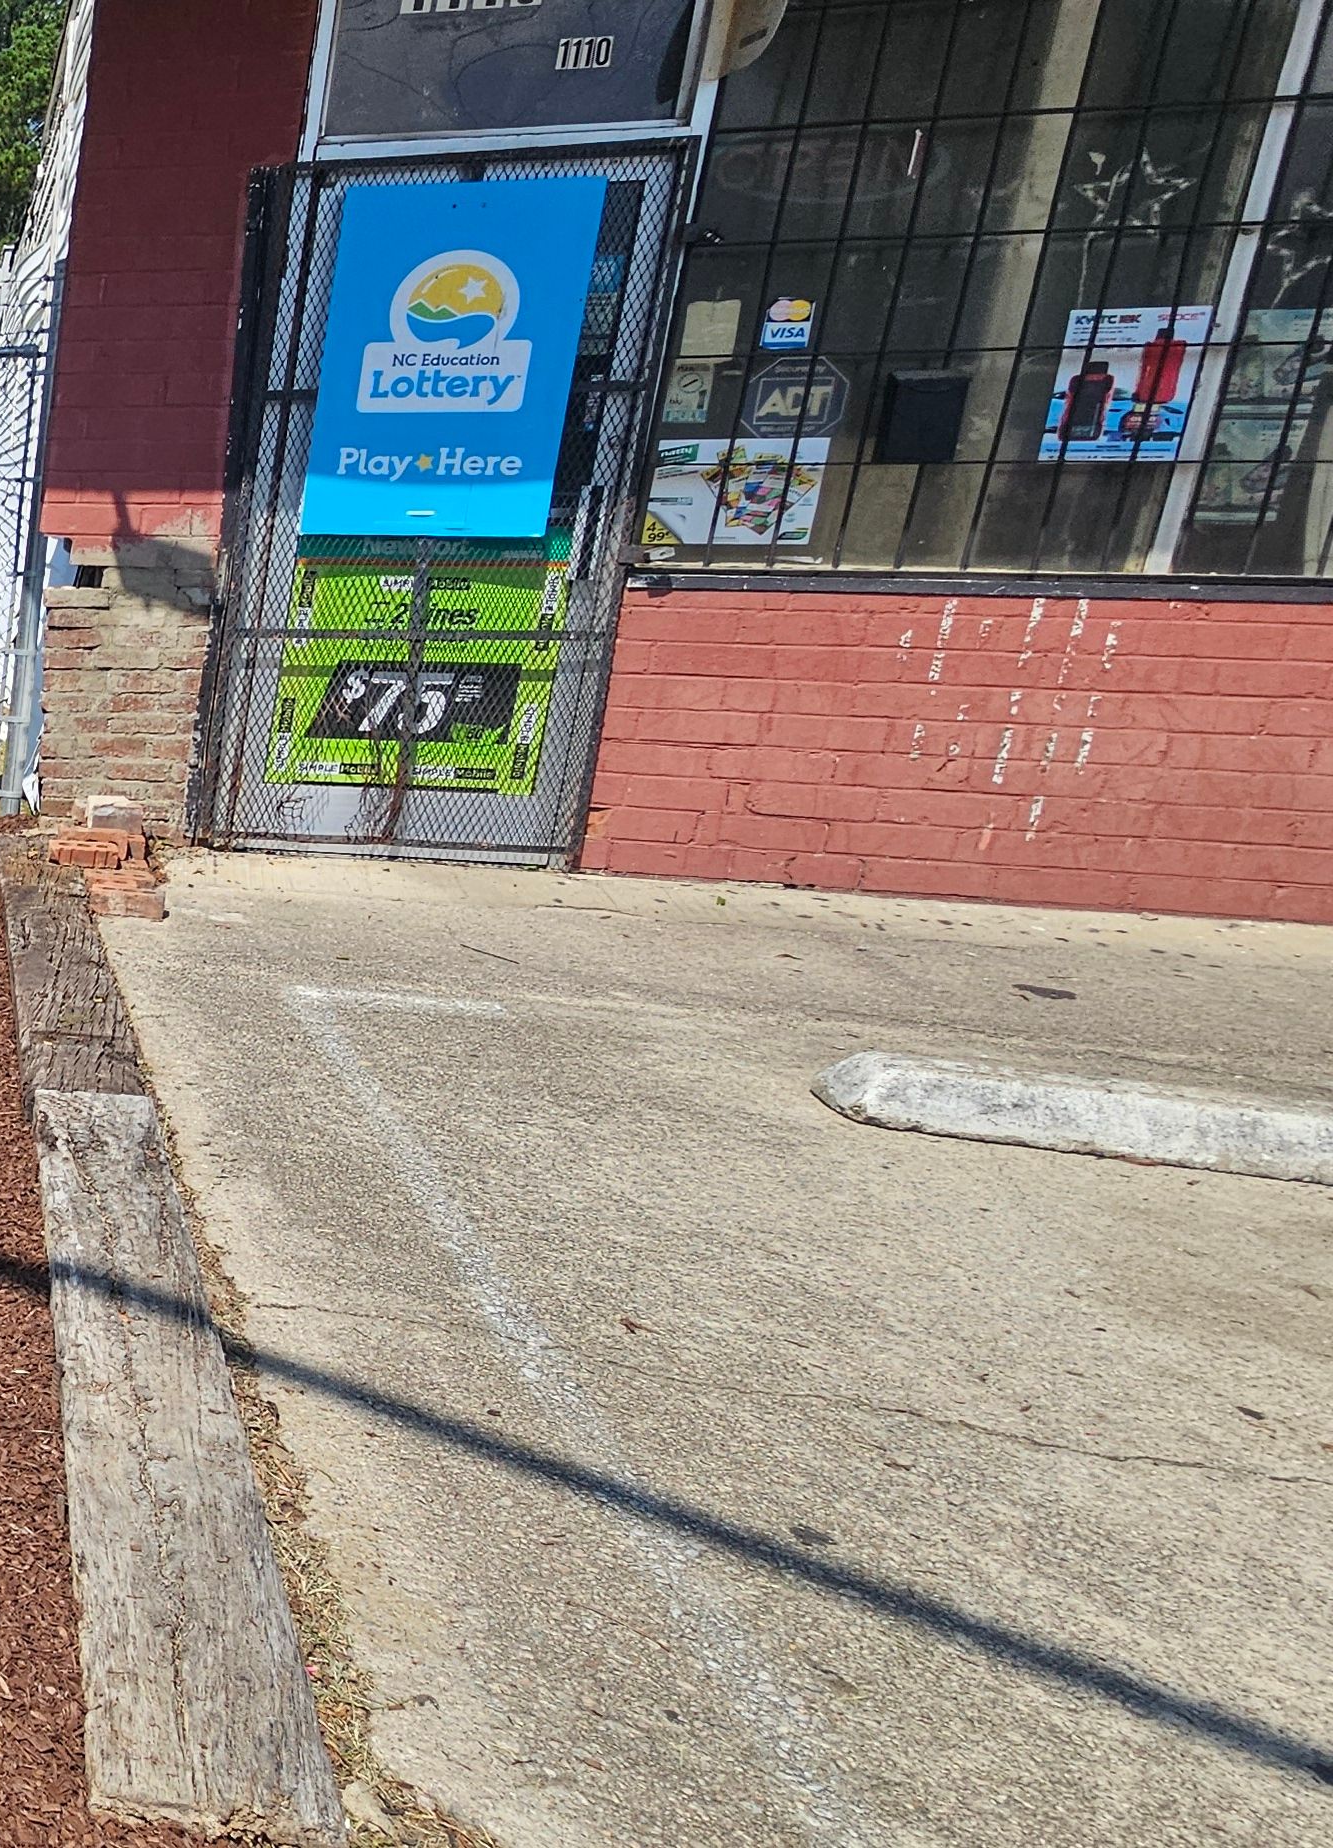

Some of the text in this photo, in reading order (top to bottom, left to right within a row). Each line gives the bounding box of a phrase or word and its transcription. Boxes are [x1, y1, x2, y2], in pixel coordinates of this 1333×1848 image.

[560, 38, 611, 68] 1110
[771, 327, 806, 339] VISA
[392, 353, 500, 367] NC Education
[369, 370, 515, 406] Lottery
[756, 386, 833, 417] ADT
[336, 447, 523, 482] Play Here
